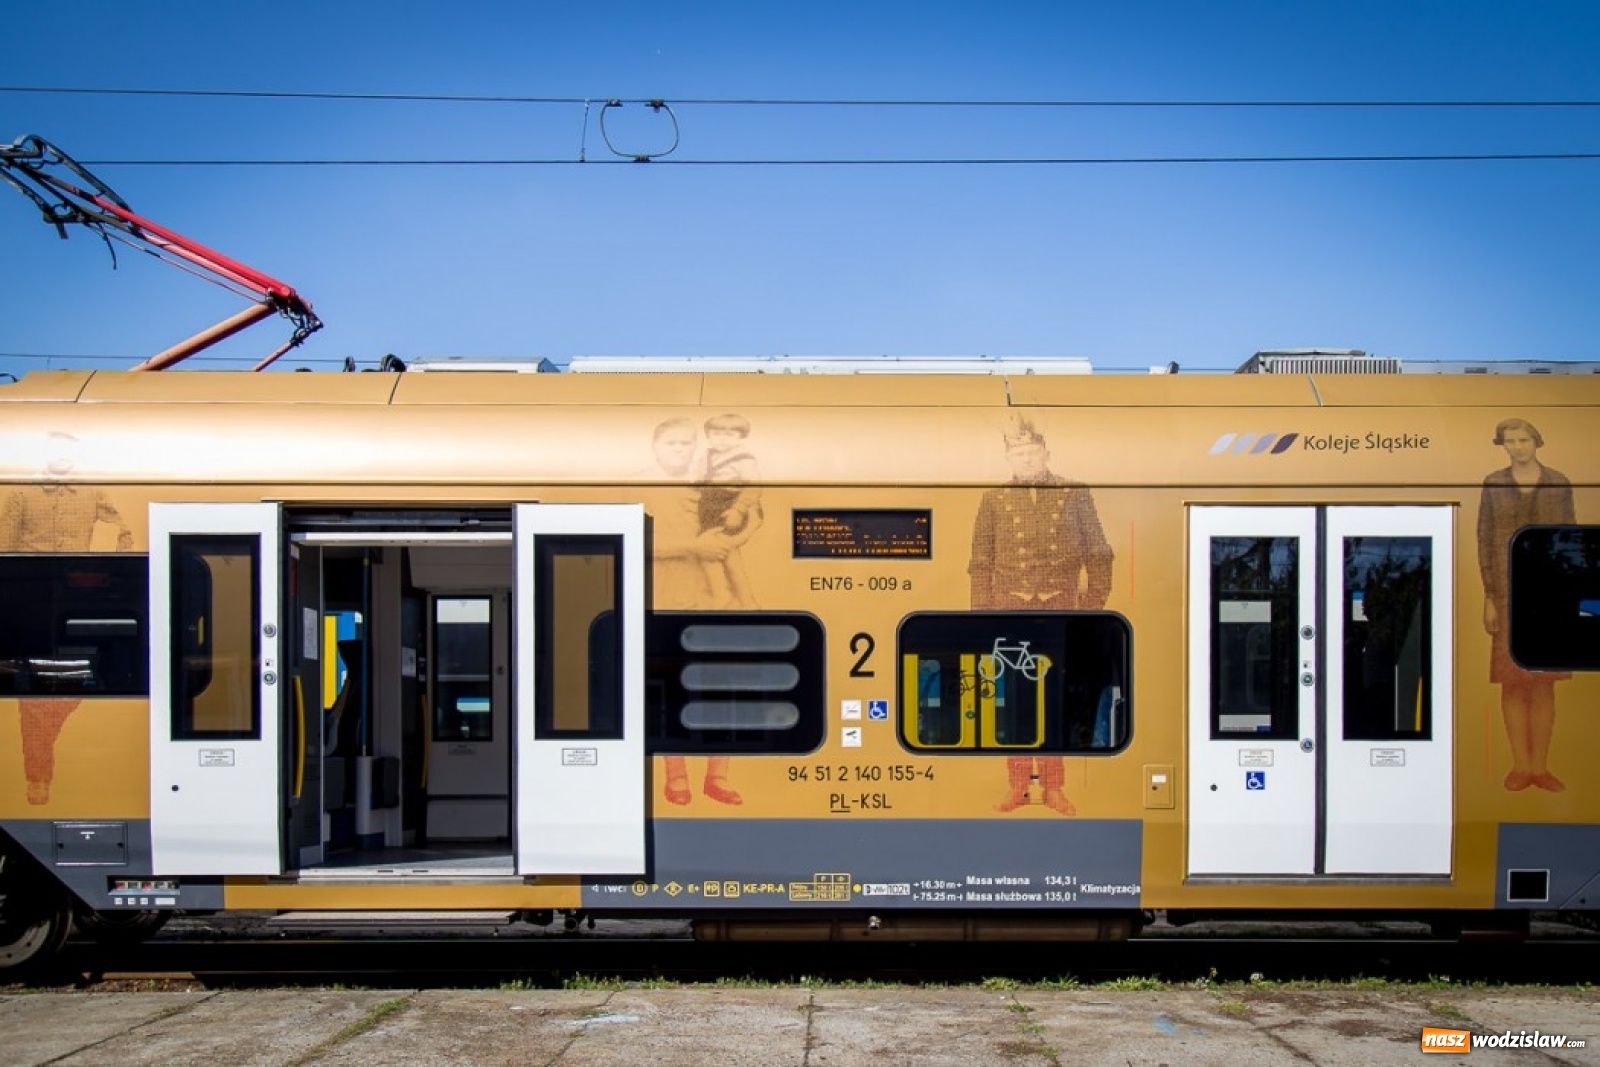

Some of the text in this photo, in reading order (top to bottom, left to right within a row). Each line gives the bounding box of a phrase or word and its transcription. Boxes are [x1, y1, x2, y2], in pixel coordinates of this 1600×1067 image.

[1303, 431, 1430, 453] Koleje Śląskie
[810, 576, 853, 591] EN76
[868, 576, 897, 591] 009
[902, 579, 912, 591] a
[849, 632, 876, 678] 2
[788, 765, 934, 781] 94 51 2 140 155-4
[830, 793, 892, 810] PL-KSL
[743, 883, 785, 893] KE-PR-A
[966, 875, 993, 885] Masa
[1044, 875, 1072, 887] 134,3
[966, 891, 993, 902] Masa
[1044, 891, 1072, 903] 135,0
[1080, 883, 1141, 896] Klimatyzacja
